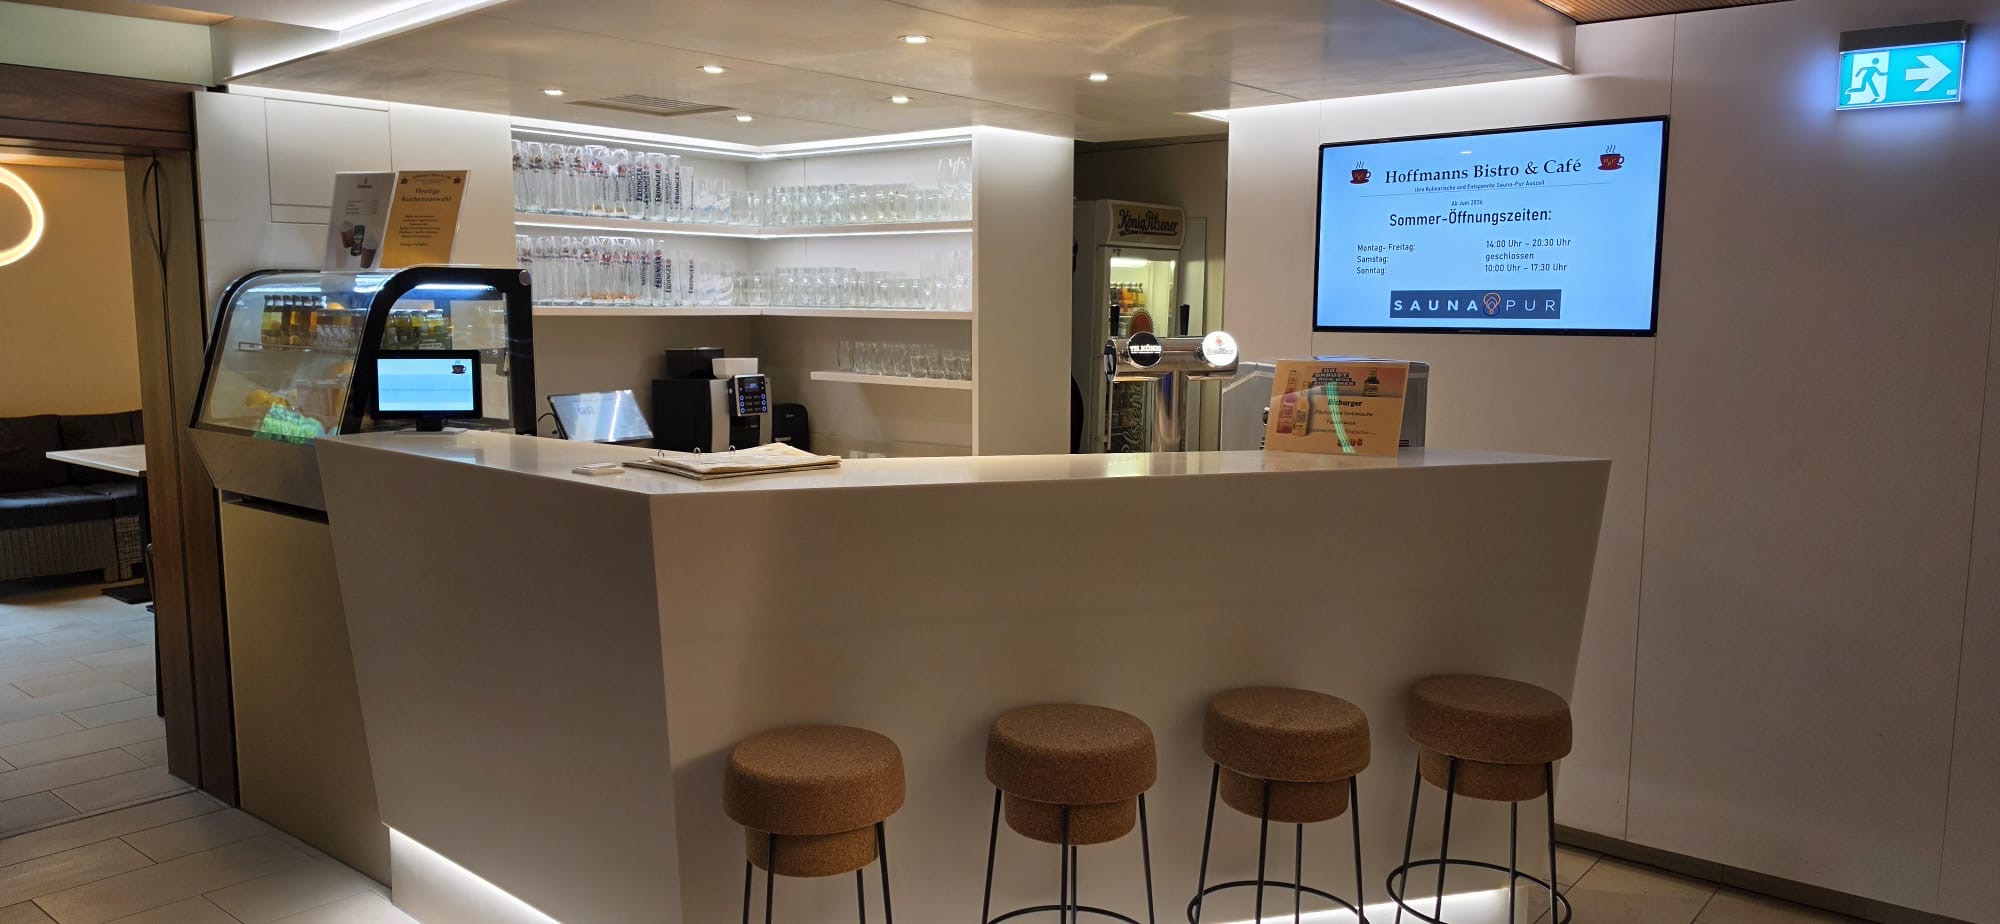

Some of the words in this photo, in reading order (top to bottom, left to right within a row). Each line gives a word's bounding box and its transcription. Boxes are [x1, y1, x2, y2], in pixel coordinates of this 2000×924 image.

[1384, 168, 1469, 184] Hoffmanns
[1473, 164, 1519, 178] Bistro
[1524, 161, 1539, 175] &
[1543, 158, 1582, 174] Café
[1389, 208, 1552, 227] Sommer-Öffnungszeiten:
[1486, 240, 1506, 248] 14:00
[1508, 239, 1522, 248] Uhr
[1532, 238, 1554, 247] 20:30
[1556, 238, 1572, 246] Uhr
[1356, 255, 1389, 264] Samstag:
[1485, 252, 1534, 262] geschlossen
[1356, 266, 1387, 275] Sonntag:
[1485, 264, 1505, 272] 10:00
[1507, 263, 1521, 272] Uhr
[1531, 263, 1551, 271] 17:30
[1553, 262, 1568, 271] Uhr
[1393, 299, 1479, 311] SAUNA
[1505, 299, 1557, 312] PUR
